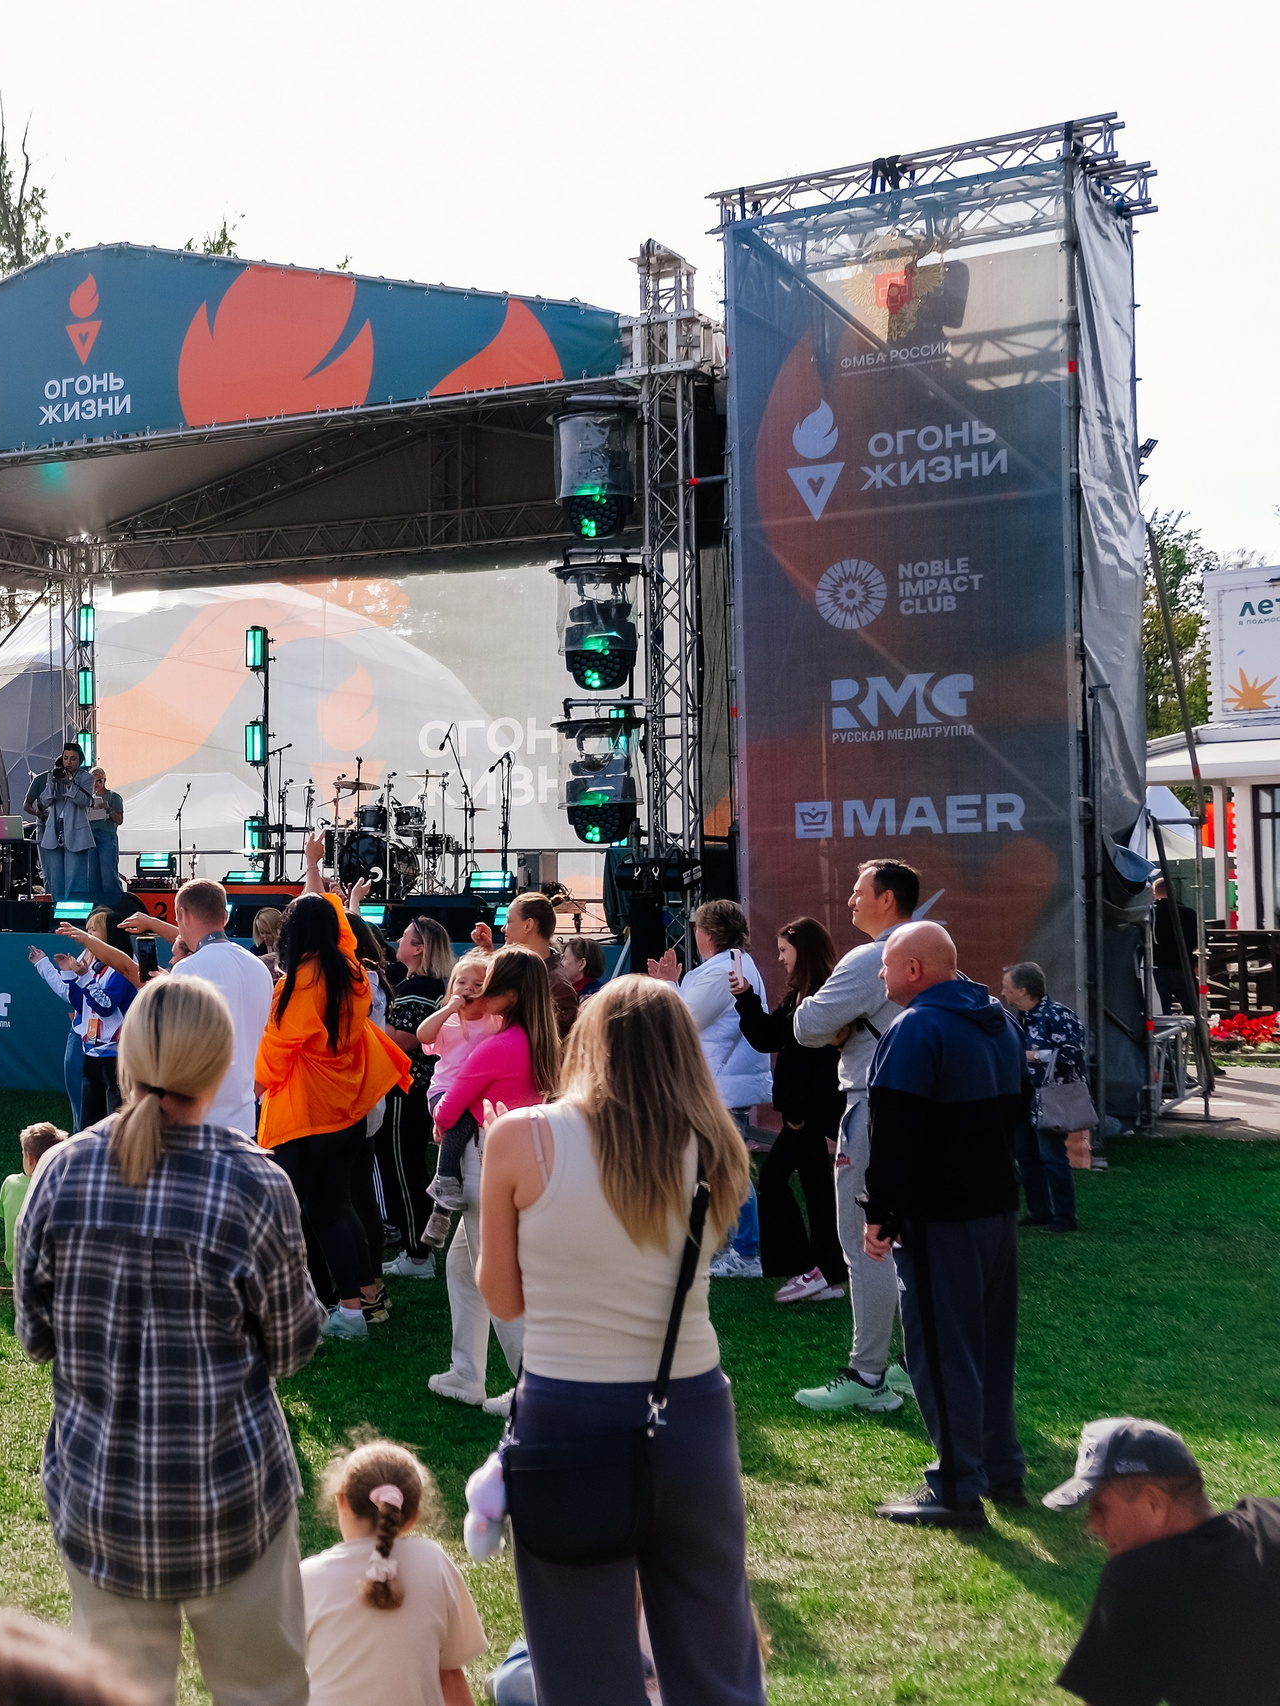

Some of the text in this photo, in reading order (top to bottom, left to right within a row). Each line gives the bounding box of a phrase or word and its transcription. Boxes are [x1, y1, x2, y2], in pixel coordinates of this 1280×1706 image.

[840, 352, 886, 369] ФМБА
[890, 341, 952, 361] РОССИИ
[44, 372, 125, 400] ОГОНЬ
[39, 394, 131, 426] ЖИЗНИ
[868, 420, 997, 458] ОГОНЬ
[860, 449, 1008, 491] ЖИЗНИ
[898, 557, 969, 579] NOBLE
[898, 574, 984, 597] IMPACT
[899, 595, 957, 616] CLUB
[830, 672, 974, 730] RMG
[418, 717, 561, 758] ОГОН
[832, 724, 975, 744] РУССКАЯ МЕДИАГРУППА
[406, 765, 558, 807] ЖИЗН
[843, 793, 1026, 838] MAER
